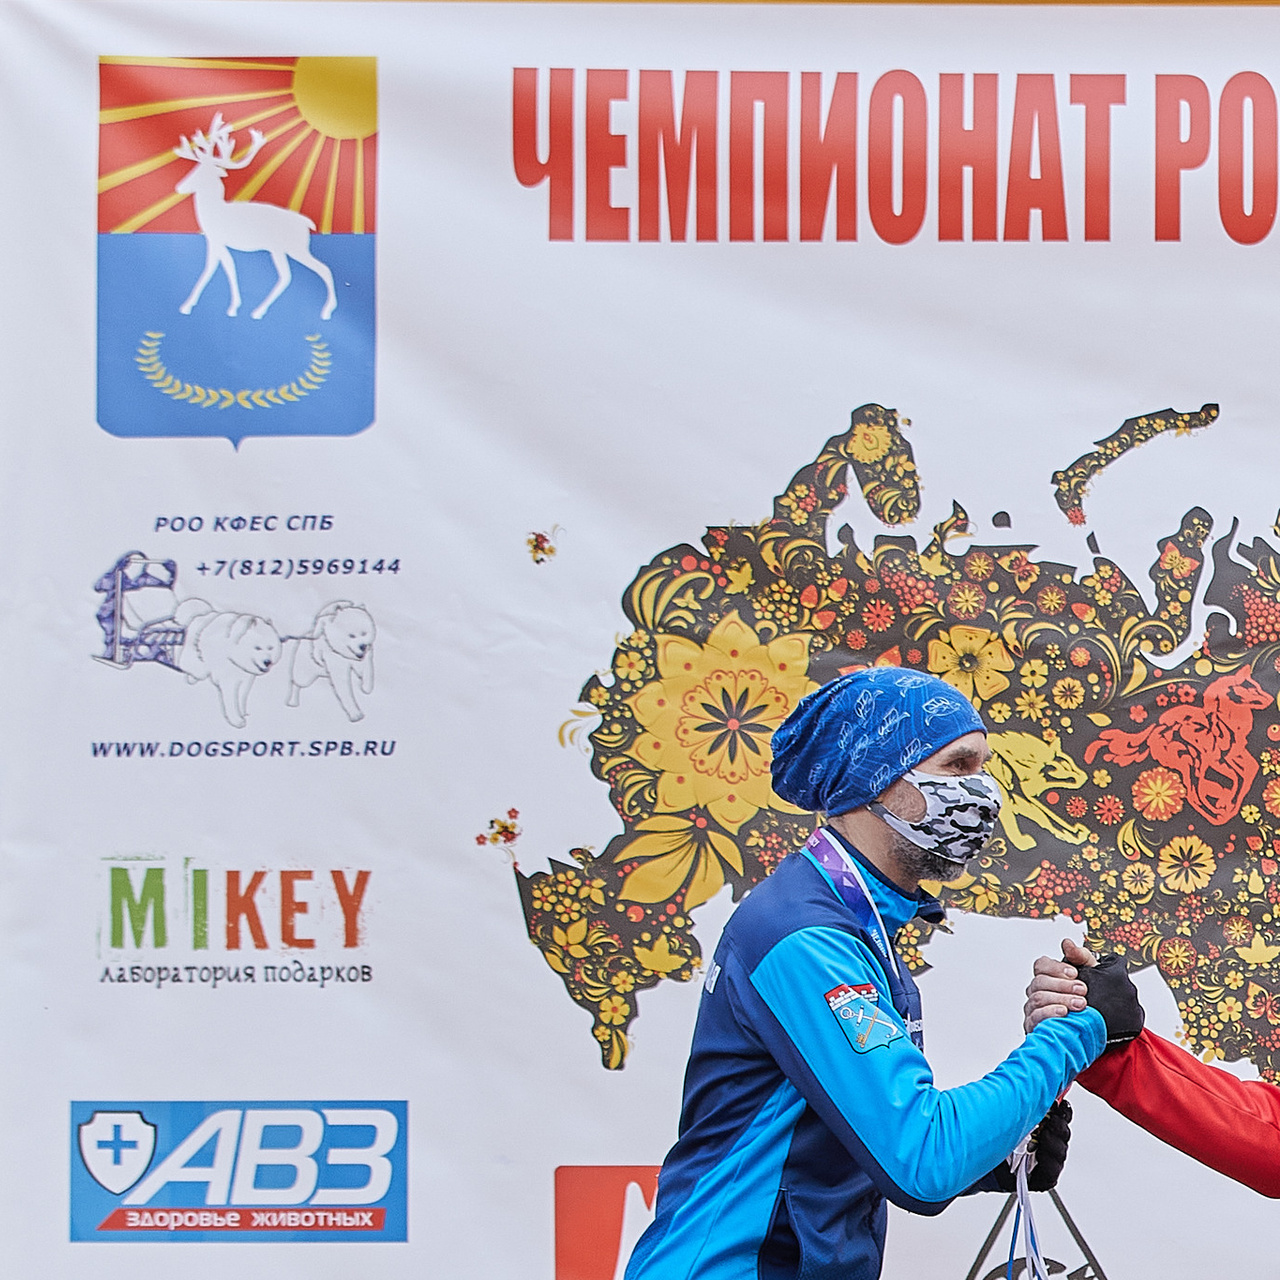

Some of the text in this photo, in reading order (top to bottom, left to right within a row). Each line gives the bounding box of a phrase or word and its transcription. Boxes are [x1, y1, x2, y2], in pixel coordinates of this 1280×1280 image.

[512, 67, 1126, 245] ЧЕМПИОНАТ
[154, 514, 335, 532] РОО КФЕС СПБ
[196, 558, 401, 580] +7(812)5969144
[91, 740, 396, 758] WWW.DOGSPORT.SPB.RU
[108, 866, 372, 951] MIKEY
[100, 960, 373, 988] лаборатория подарков
[122, 1109, 399, 1205] АВЗ
[126, 1211, 373, 1229] здоровье животных
